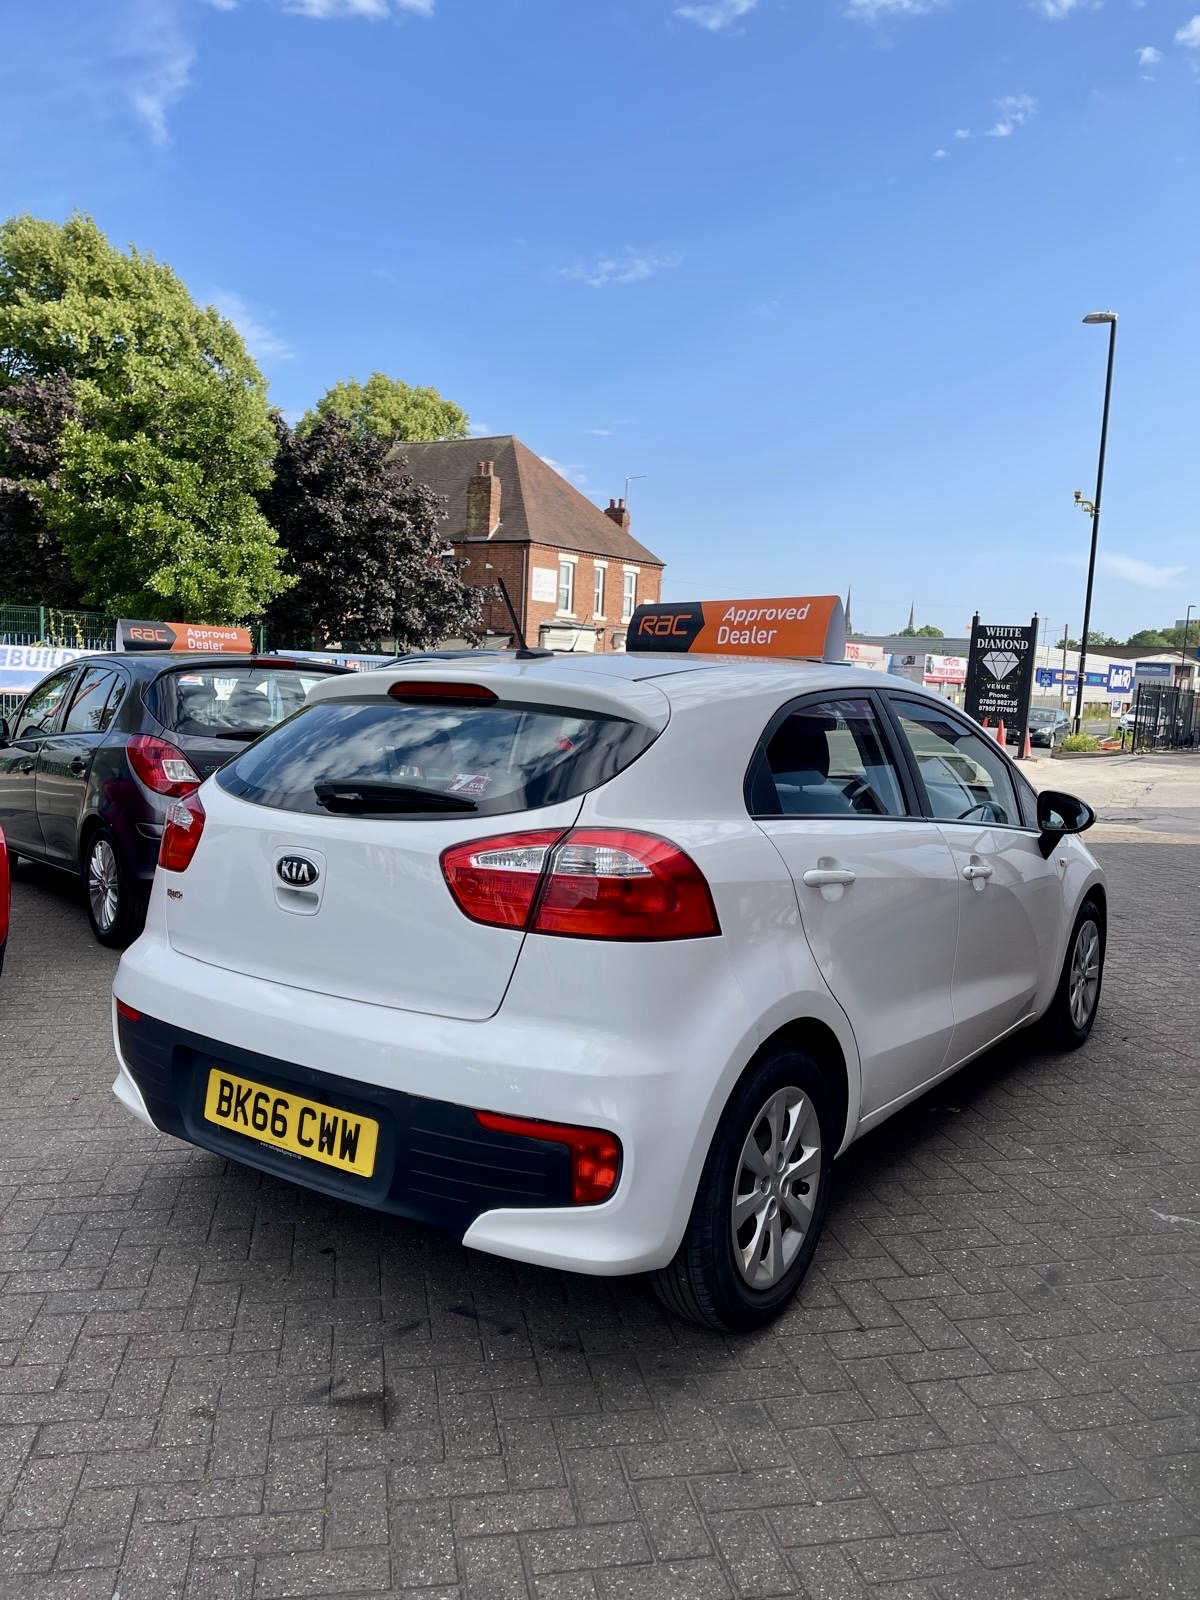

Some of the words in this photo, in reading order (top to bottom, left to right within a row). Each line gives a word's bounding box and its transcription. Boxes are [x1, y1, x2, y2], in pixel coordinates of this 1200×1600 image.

[722, 603, 810, 626] Approved
[187, 627, 238, 642] Approved
[717, 626, 778, 645] Dealer
[985, 627, 1022, 638] WHITE
[187, 638, 225, 651] Dealer
[976, 638, 1029, 650] DIAMOND
[9, 649, 88, 669] BUILD
[281, 860, 311, 882] KIA
[216, 1078, 290, 1139] BK66
[297, 1106, 361, 1164] CWW
